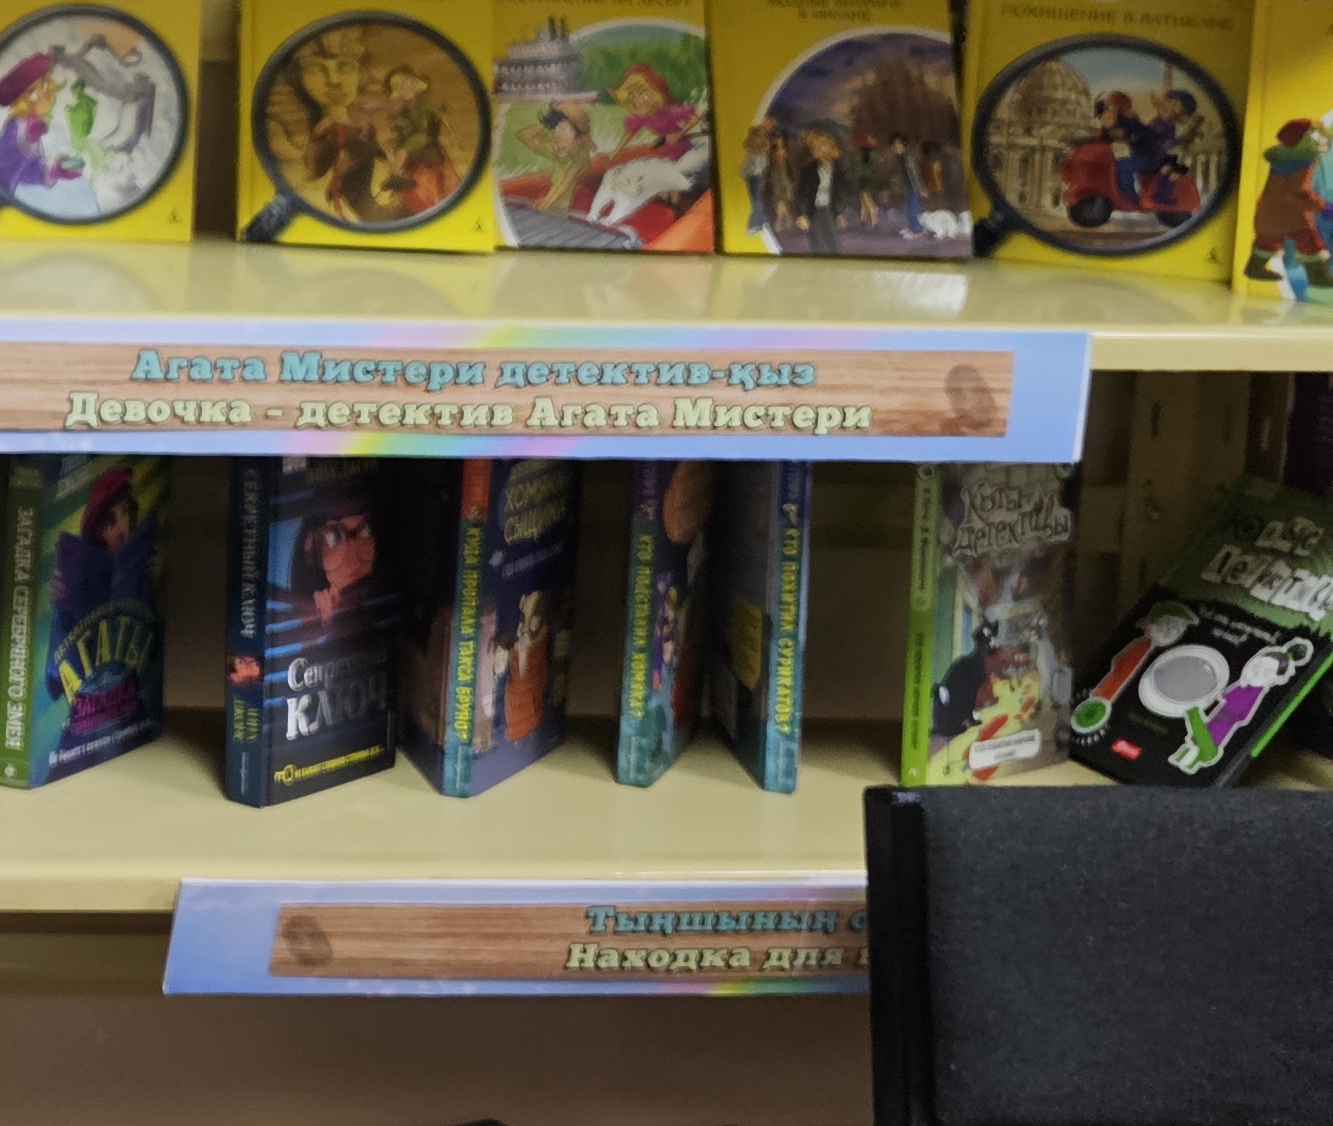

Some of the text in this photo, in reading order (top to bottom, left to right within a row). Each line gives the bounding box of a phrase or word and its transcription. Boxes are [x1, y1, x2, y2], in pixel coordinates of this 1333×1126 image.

[132, 350, 817, 392] Агата Мистери детектив-қыз
[64, 390, 873, 436] Девочка детектив Агата Мистери
[14, 505, 34, 582] ЗАГАДКА
[8, 585, 30, 702] СЕРЕБРЯНОГО
[453, 526, 482, 743] КУДА ПРОПАЛА ТАКСА БРУНО?
[628, 534, 655, 720] КТО ПОДСТАВИЛ ХОМЯКА?
[774, 527, 801, 735] КТО ПОХИТИЛ СУРИКАТОВ?
[564, 942, 843, 972] Находка для
[586, 905, 838, 937] Тыңшының
